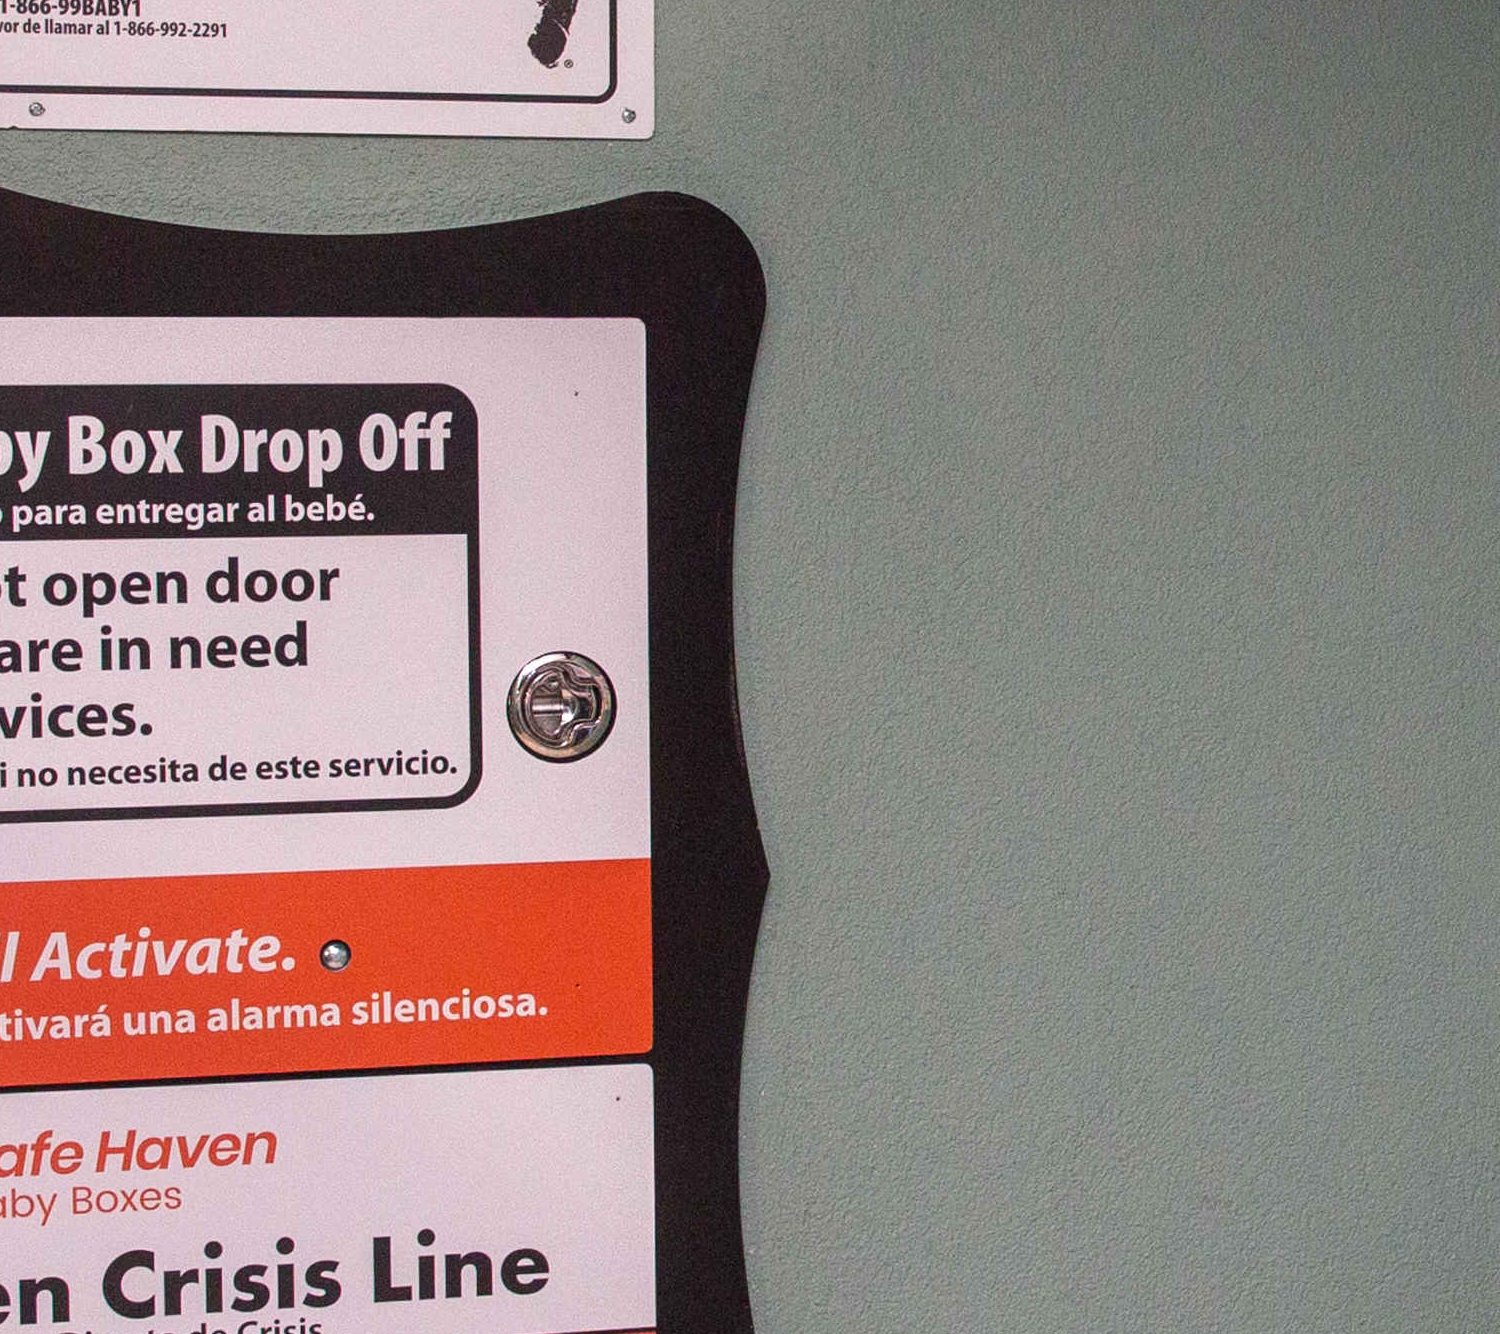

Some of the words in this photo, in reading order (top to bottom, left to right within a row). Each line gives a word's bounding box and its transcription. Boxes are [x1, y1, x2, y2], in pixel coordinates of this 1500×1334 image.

[69, 415, 184, 474] Box
[202, 414, 343, 488] Drop
[359, 411, 453, 471] Off
[13, 503, 86, 532] para
[96, 500, 239, 530] entregar
[248, 494, 275, 522] al
[285, 494, 375, 521] bebé.
[43, 571, 188, 618] open
[206, 556, 340, 603] door
[101, 625, 150, 671] in
[170, 620, 308, 669] need
[18, 768, 58, 787] no
[68, 757, 199, 785] necesita
[208, 755, 247, 781] de
[256, 756, 320, 780] este
[329, 749, 457, 778] servicio.
[30, 927, 295, 981] Activate.
[123, 1010, 195, 1036] una
[207, 998, 340, 1032] alarma
[352, 988, 548, 1025] silenciosa.
[95, 1130, 278, 1175] Haven
[70, 1186, 183, 1216] Boxes
[100, 1238, 342, 1317] Crisis
[373, 1229, 549, 1303] Line
